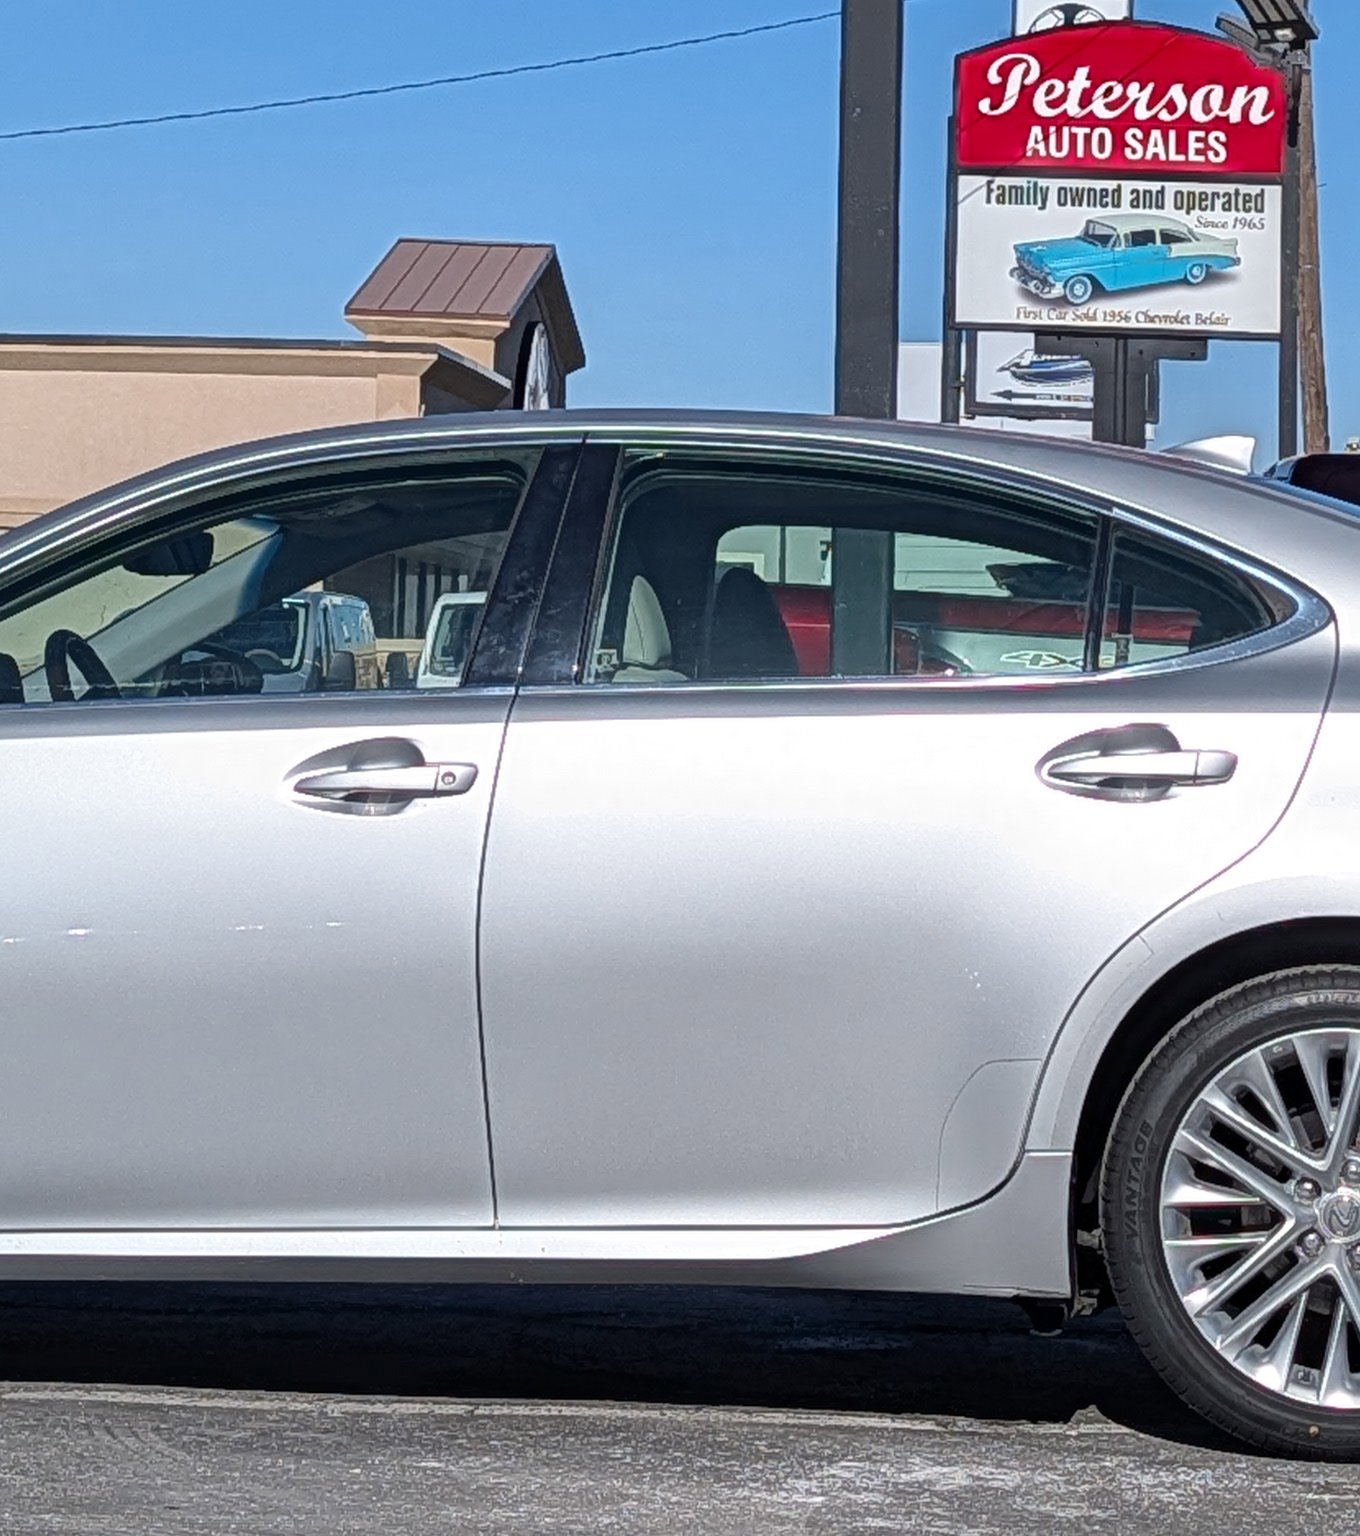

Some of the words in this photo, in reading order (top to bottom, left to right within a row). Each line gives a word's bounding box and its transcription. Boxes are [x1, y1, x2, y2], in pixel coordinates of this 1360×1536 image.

[978, 52, 1276, 126] Peterson
[1025, 125, 1113, 160] AUTO
[1124, 127, 1228, 163] SALES
[985, 179, 1050, 210] Family
[1056, 183, 1122, 209] owned
[1129, 185, 1165, 210] and
[1173, 187, 1265, 215] operated
[1194, 215, 1229, 229] Since
[1231, 216, 1266, 230] 1965
[1015, 306, 1043, 320] First
[1047, 307, 1068, 321] Car
[1071, 307, 1098, 322] Sold
[1102, 311, 1131, 323] 1956
[1134, 310, 1191, 325] Chevrolet
